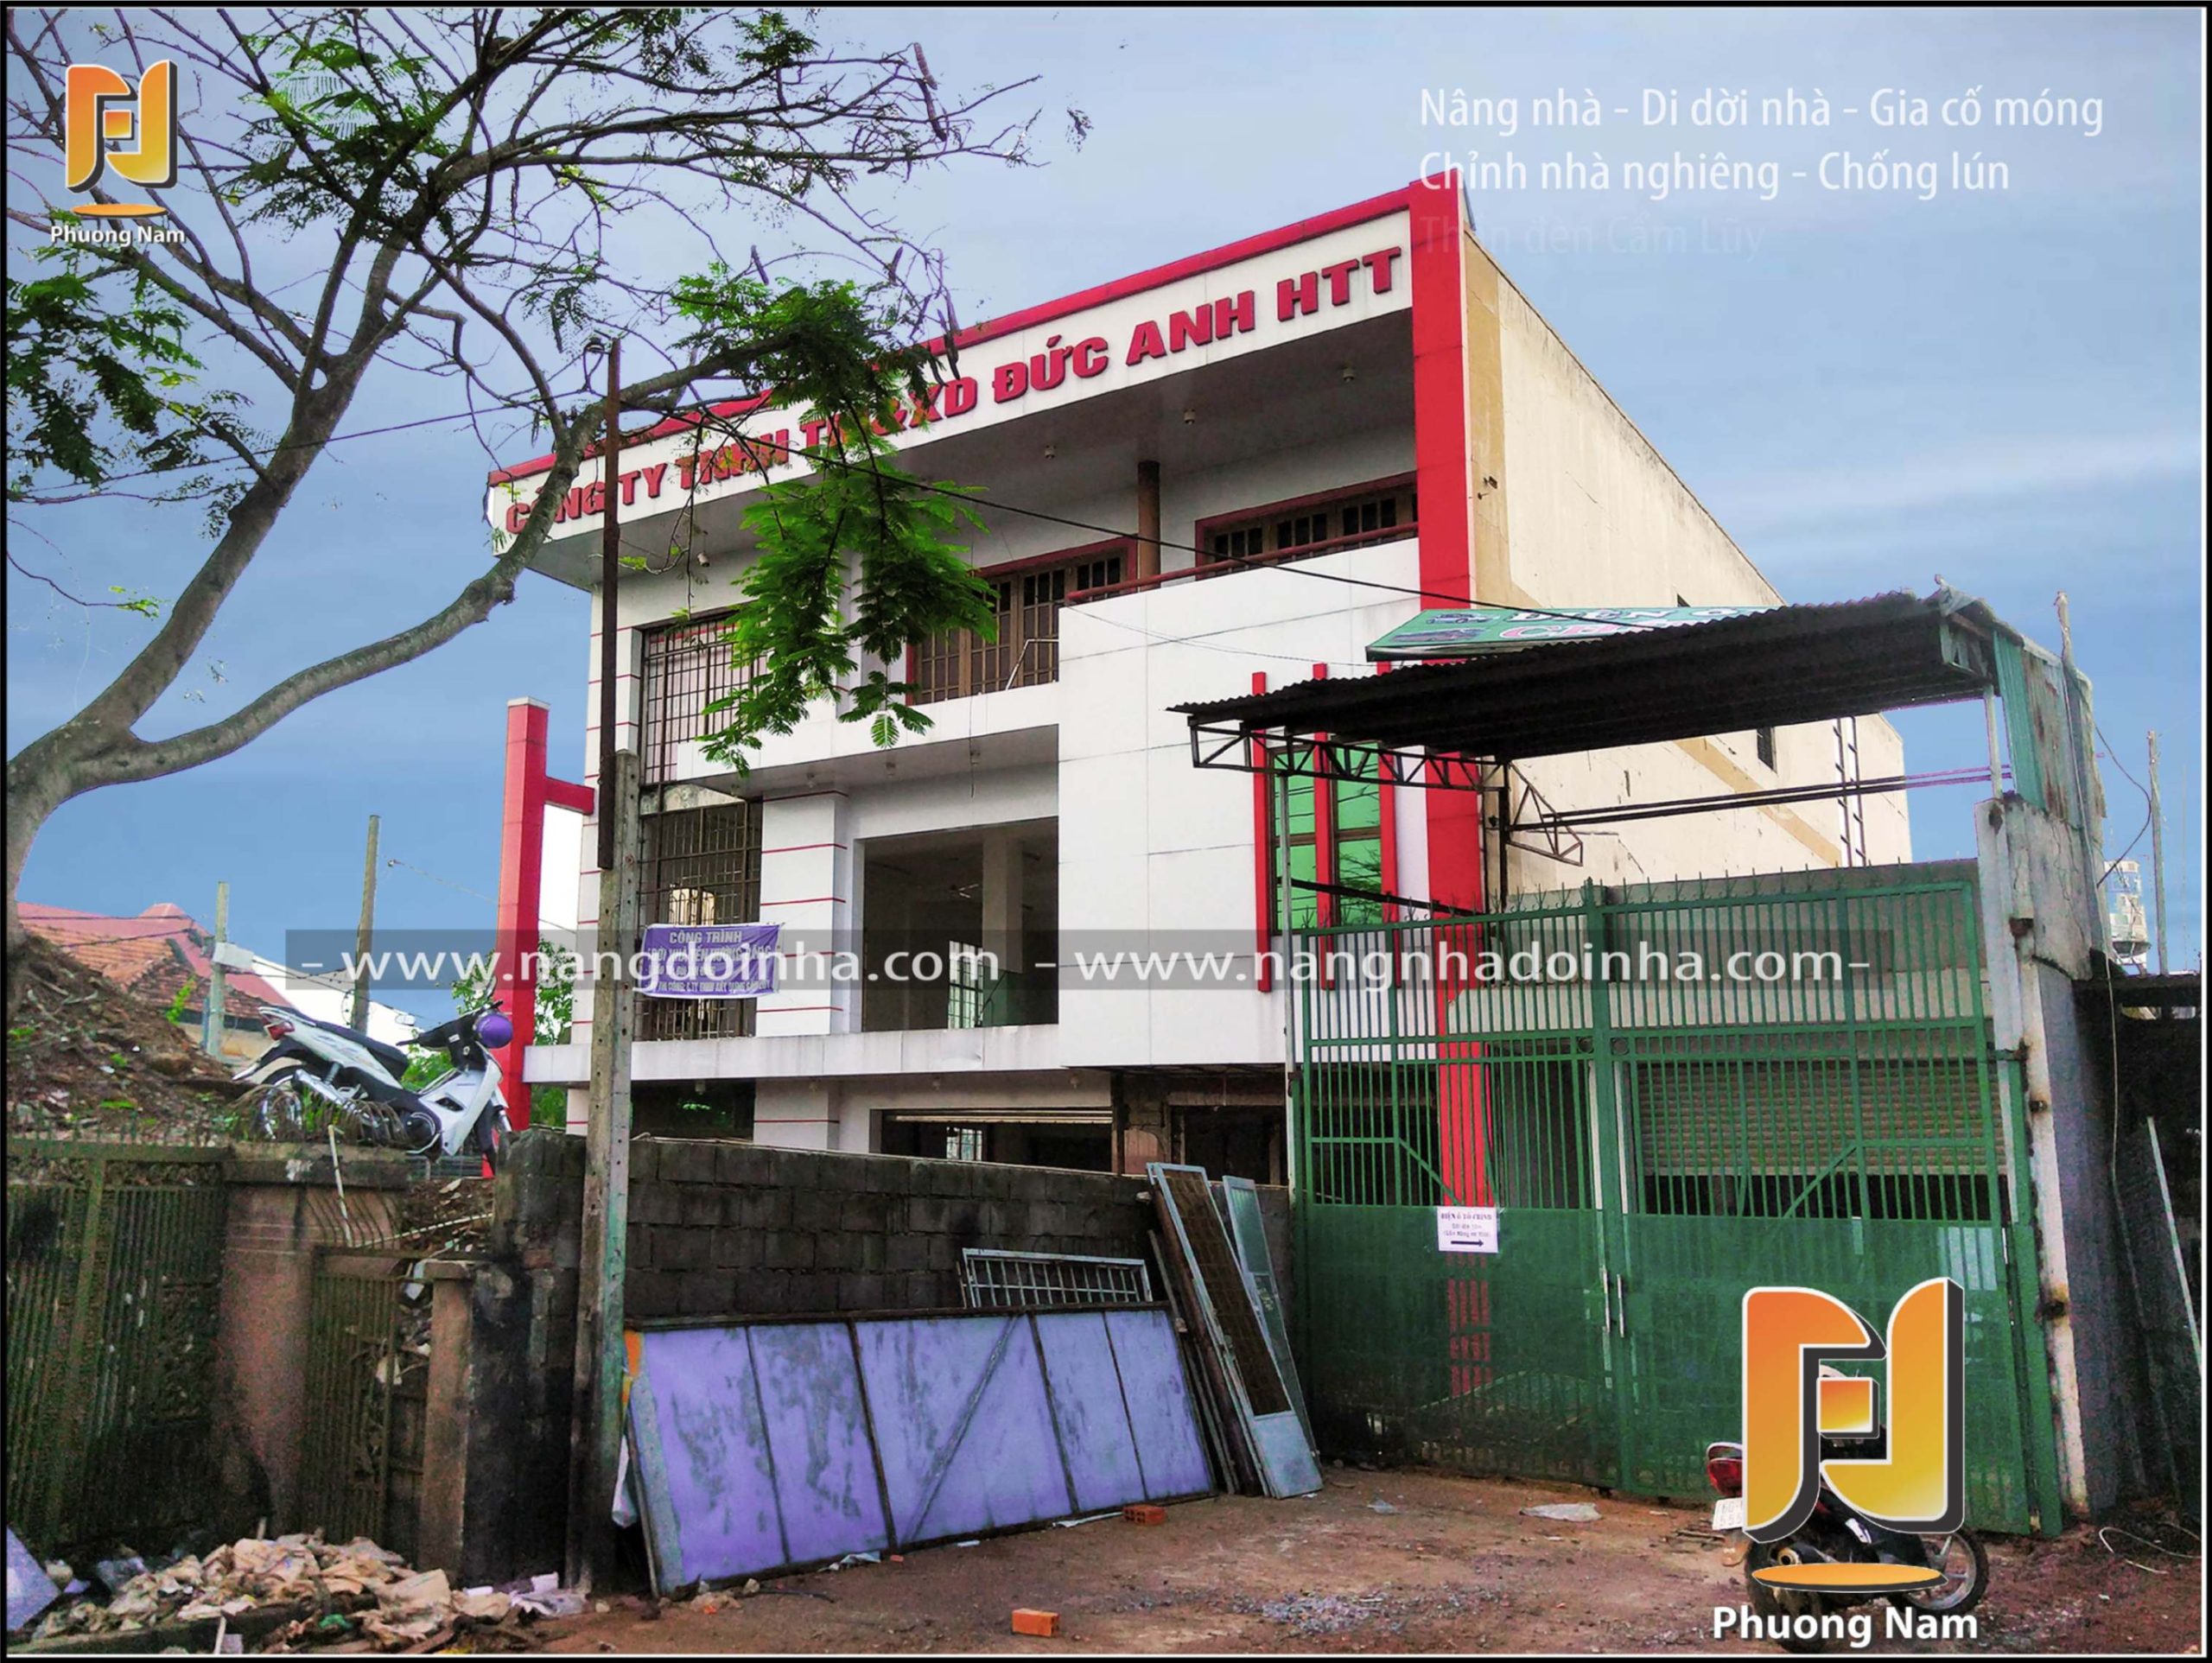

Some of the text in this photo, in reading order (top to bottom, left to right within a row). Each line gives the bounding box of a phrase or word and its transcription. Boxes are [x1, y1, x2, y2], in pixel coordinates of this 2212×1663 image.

[505, 480, 605, 535] CNG
[618, 462, 668, 506] TY
[991, 333, 1109, 404] ĐỨC
[1126, 289, 1256, 366] ANH
[1276, 245, 1402, 322] HTT
[670, 929, 743, 944] CÔNG TRÌNH
